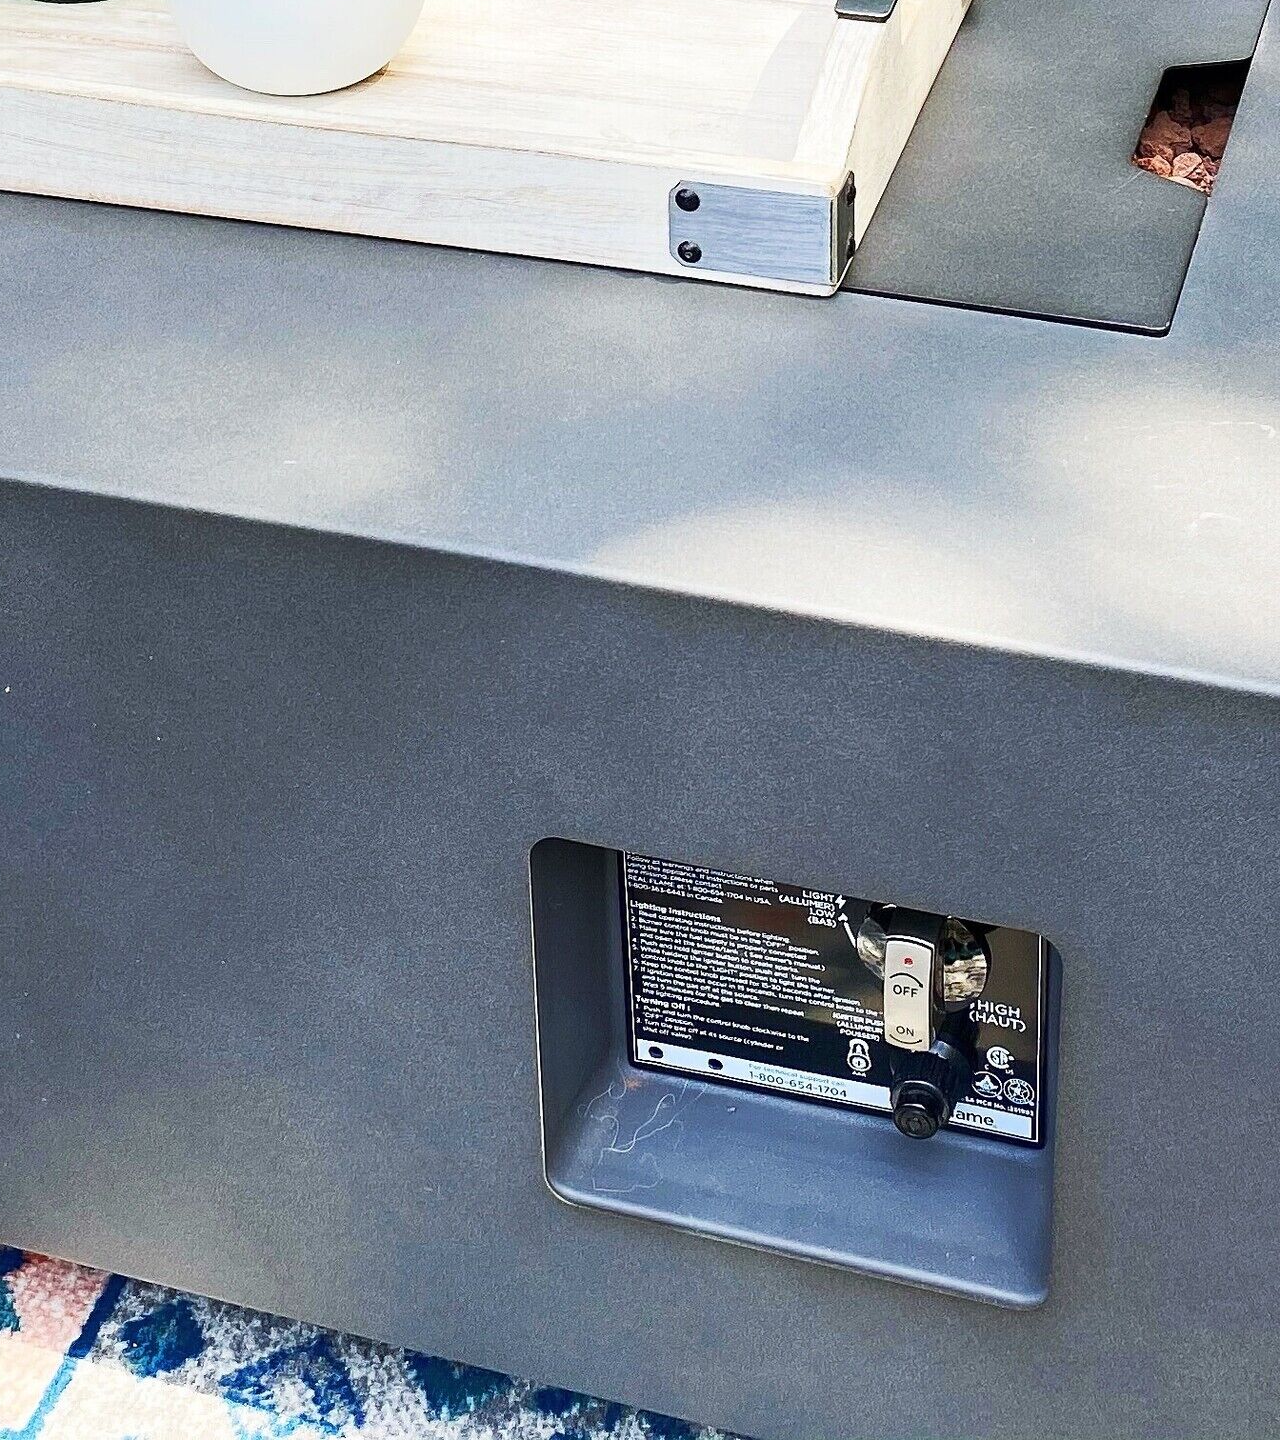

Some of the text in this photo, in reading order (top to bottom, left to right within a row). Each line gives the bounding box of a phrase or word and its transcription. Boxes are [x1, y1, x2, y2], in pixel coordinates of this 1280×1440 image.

[779, 895, 834, 911] (ALLUMER)
[803, 890, 834, 902] LIGHT
[630, 900, 720, 922] Lighting Instructions
[810, 908, 835, 918] LOW
[808, 916, 836, 927] (BAS)
[893, 984, 918, 997] OFF
[635, 995, 685, 1010] Turning Off
[978, 1000, 1020, 1018] HIGH
[969, 1010, 1026, 1032] (HAUT)
[896, 1026, 914, 1036] ON
[749, 1071, 847, 1098] 1-800-654-1704
[956, 1110, 994, 1126] ame
